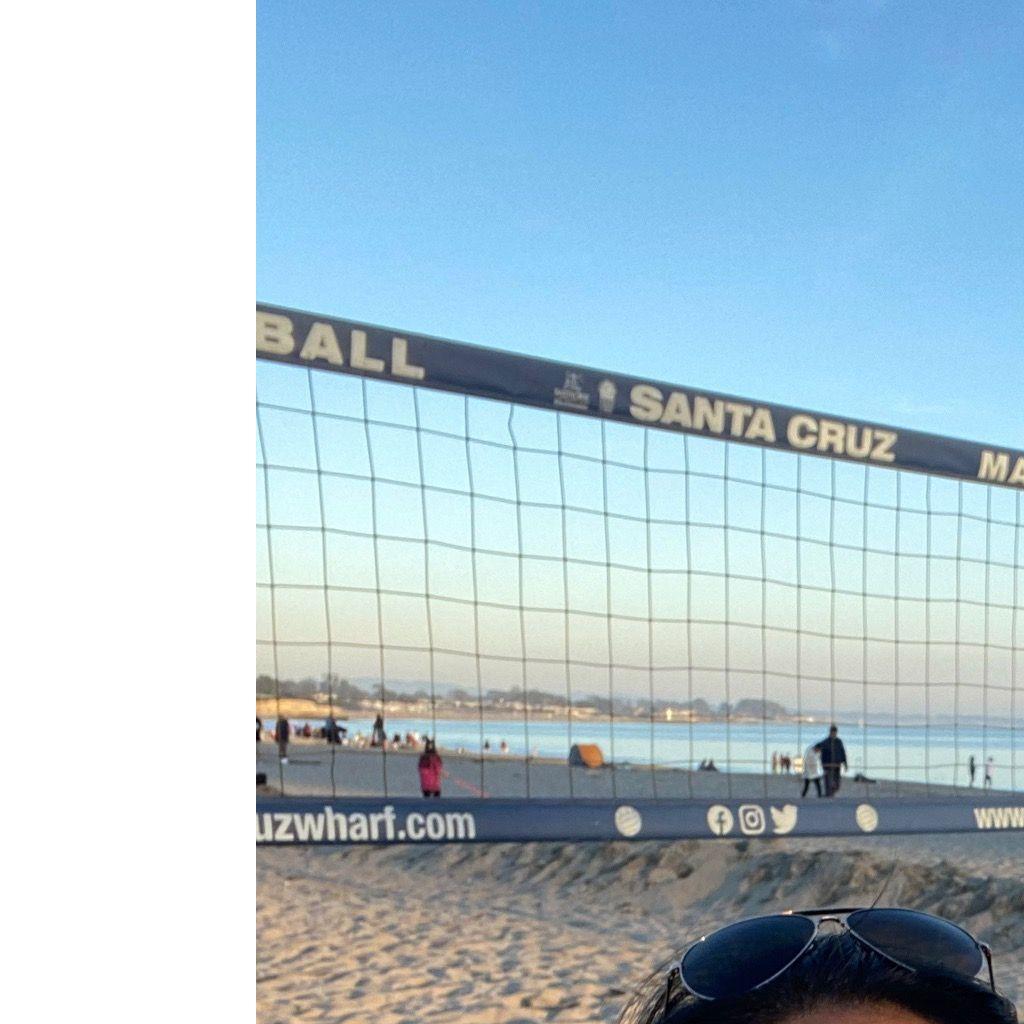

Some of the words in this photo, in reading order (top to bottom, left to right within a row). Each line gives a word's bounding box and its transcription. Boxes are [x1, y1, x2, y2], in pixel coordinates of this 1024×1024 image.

[256, 310, 425, 380] BALL
[629, 384, 776, 443] SANTA
[786, 414, 898, 463] CRUZ
[256, 805, 476, 842] uzwharf.com
